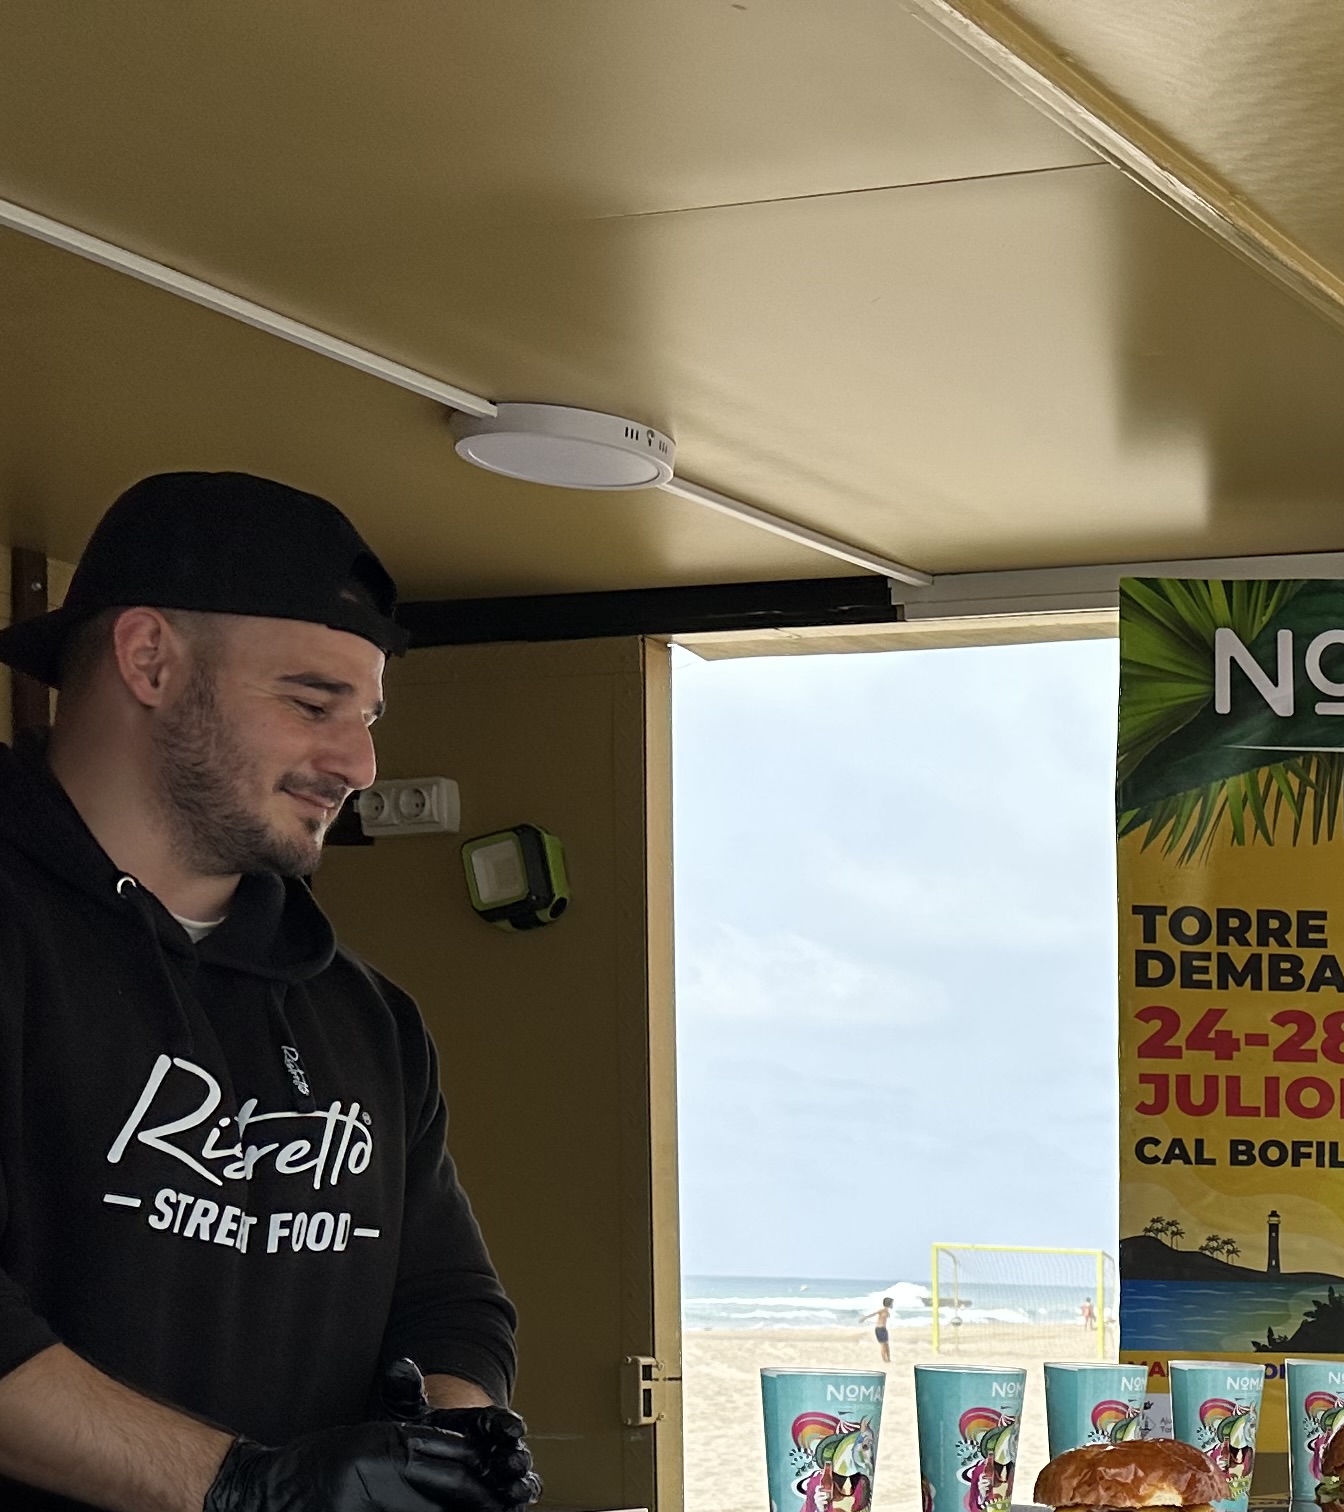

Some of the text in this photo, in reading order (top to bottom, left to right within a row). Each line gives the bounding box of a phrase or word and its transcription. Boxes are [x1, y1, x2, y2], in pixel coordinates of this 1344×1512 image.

[1132, 904, 1328, 950] TORRE
[1134, 1136, 1217, 1167] CAL
[267, 1211, 351, 1254] FOOD
